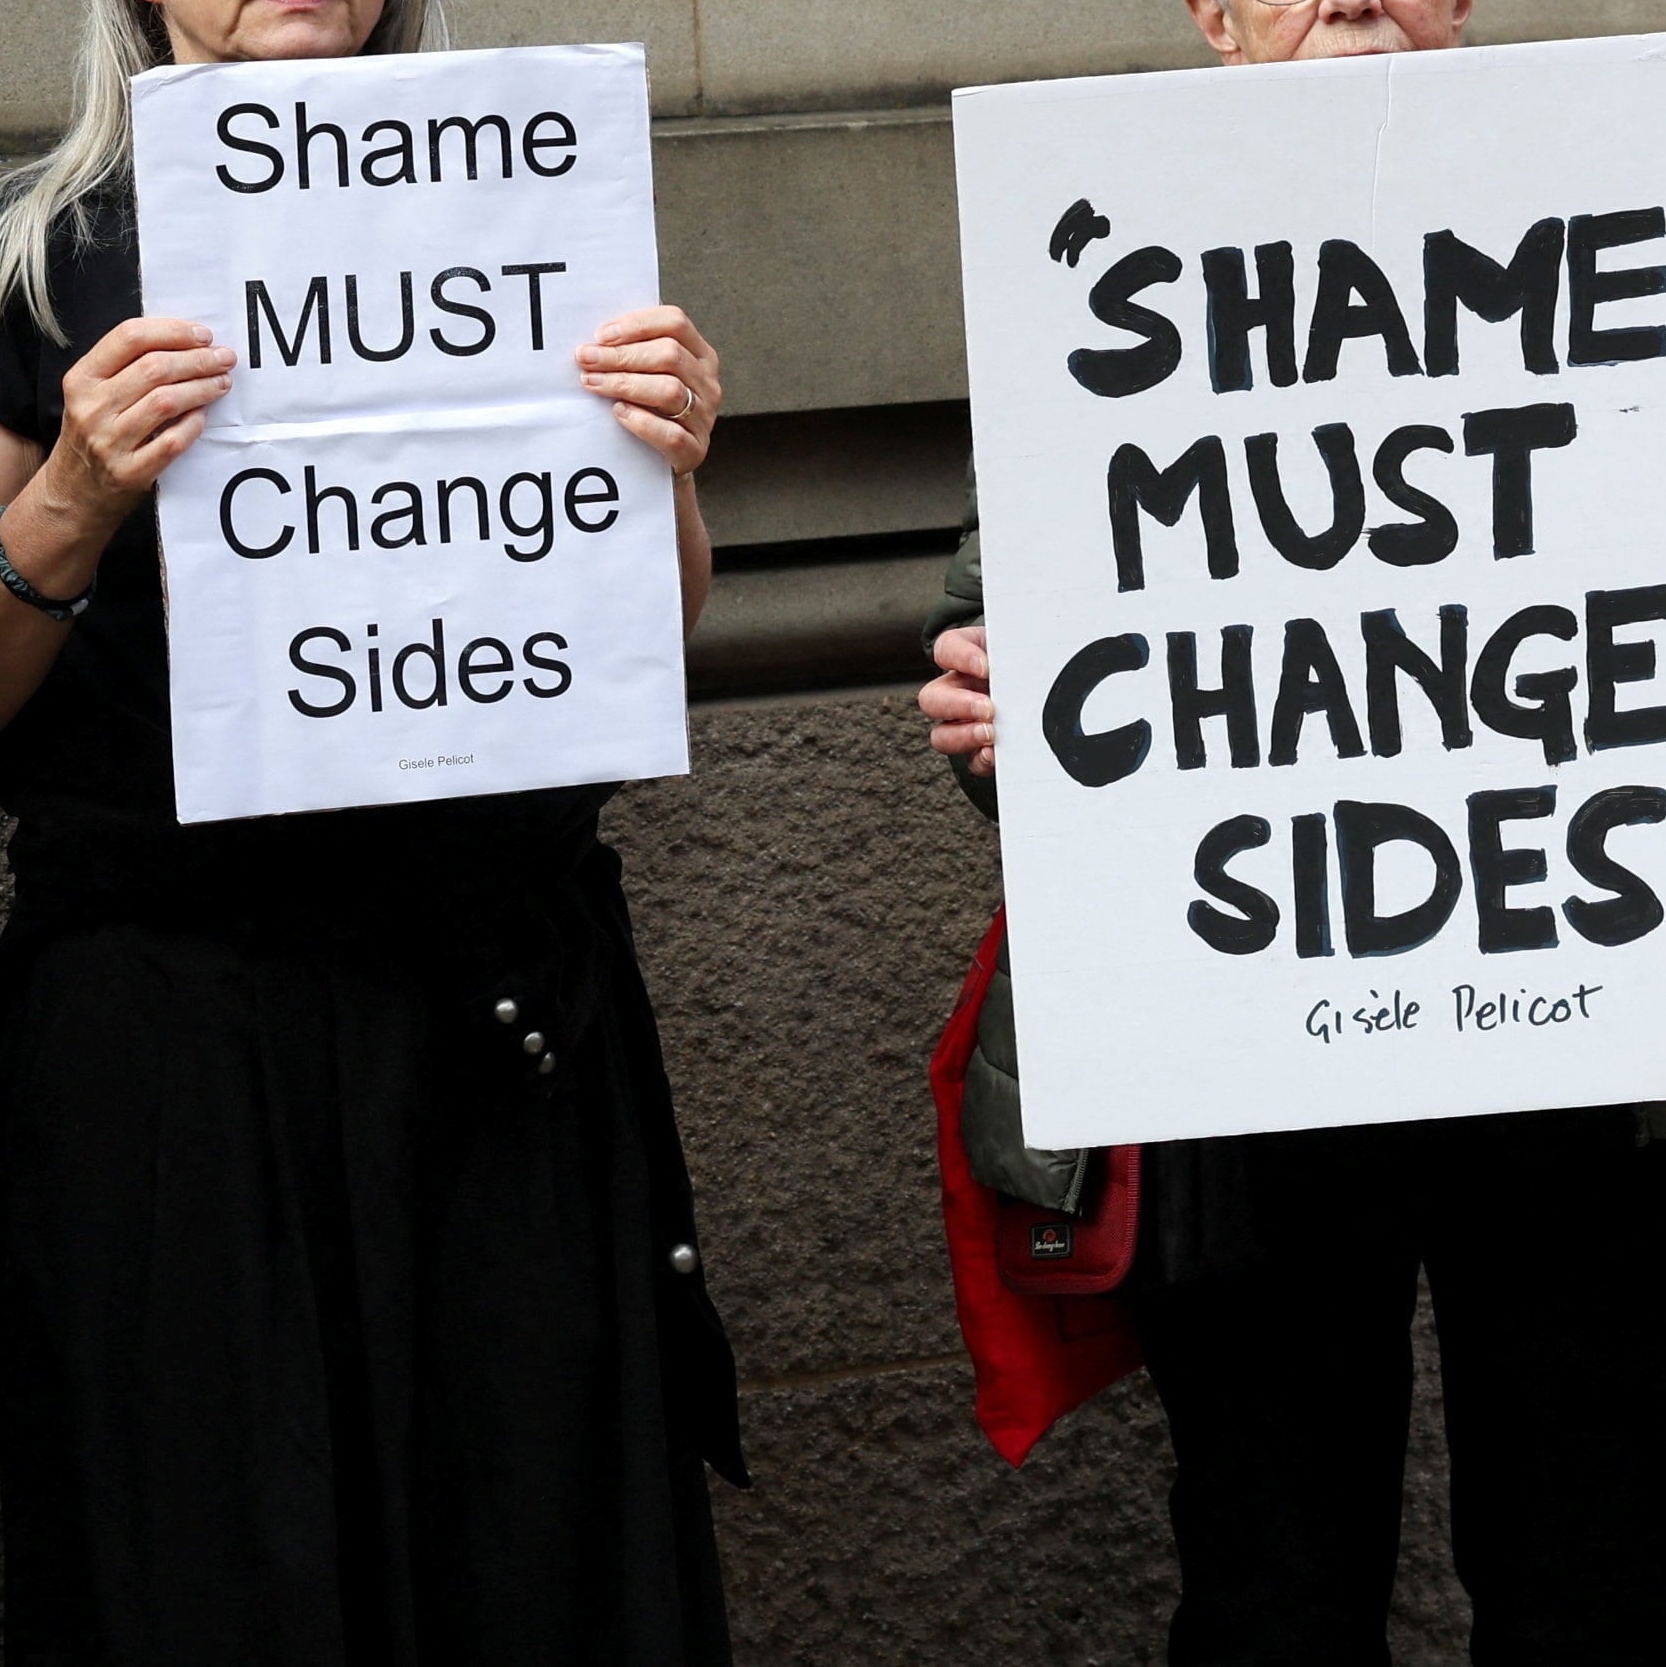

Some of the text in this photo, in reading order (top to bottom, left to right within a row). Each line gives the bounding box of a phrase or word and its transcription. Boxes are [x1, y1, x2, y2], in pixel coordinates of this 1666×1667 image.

[215, 101, 577, 194] Shame
[244, 261, 567, 370] MUST
[219, 464, 620, 563] Change
[1106, 403, 1578, 594] MUST
[287, 618, 572, 719] Sides
[398, 753, 474, 770] Gisele Pelicot
[1451, 983, 1604, 1032] Pelicot
